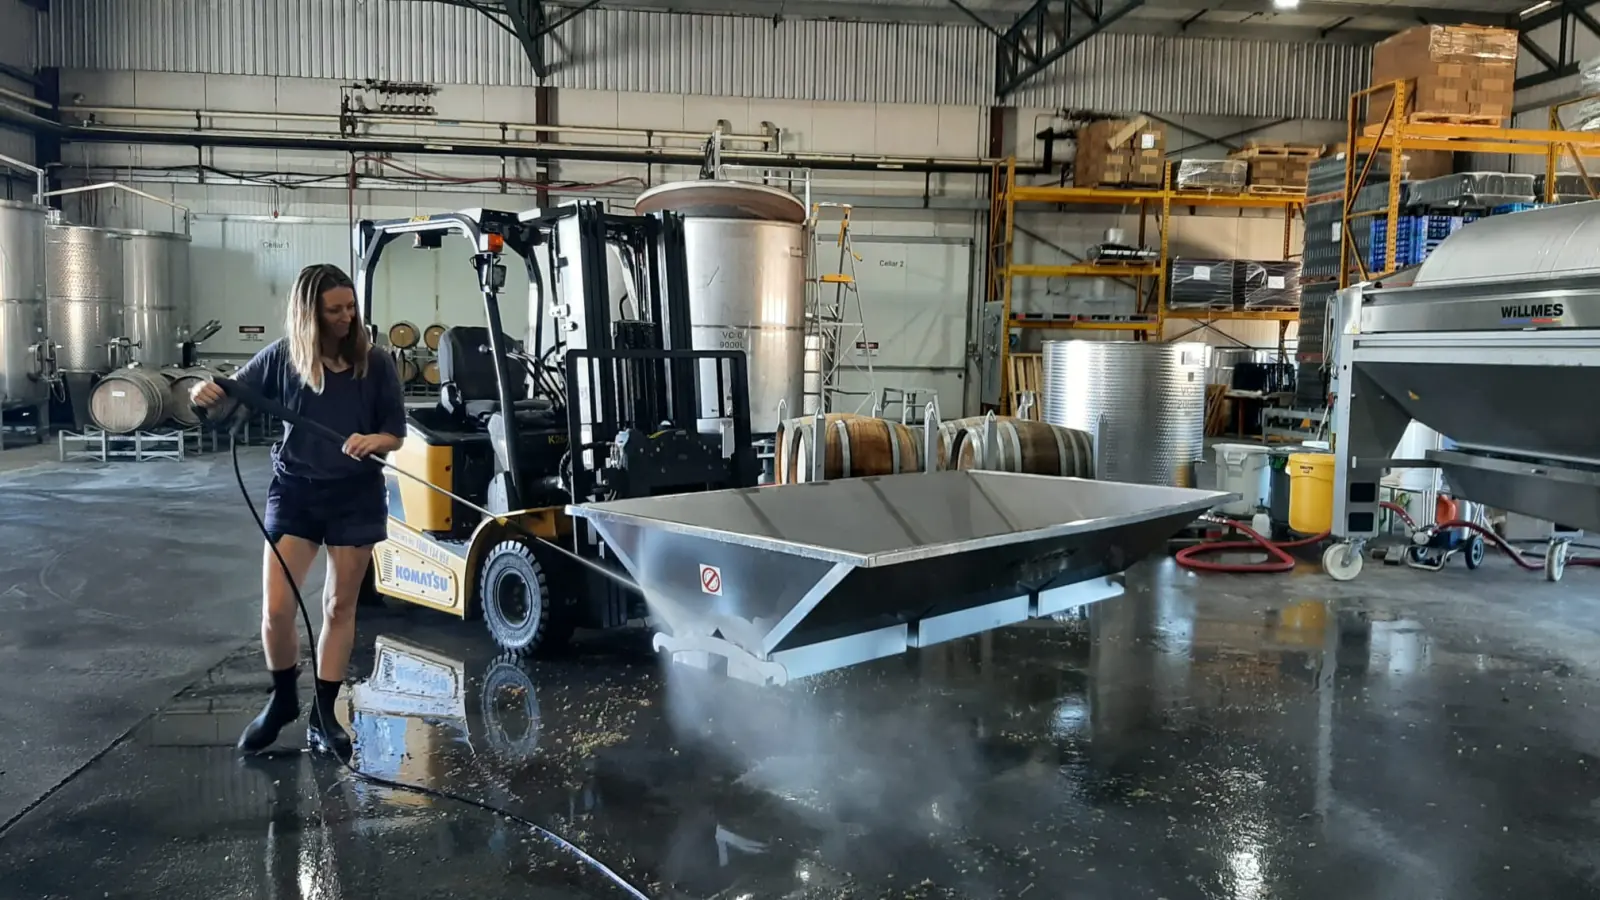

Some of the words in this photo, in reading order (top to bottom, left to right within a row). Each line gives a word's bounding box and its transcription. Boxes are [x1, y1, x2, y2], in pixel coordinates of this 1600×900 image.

[879, 259, 899, 267] Cellar
[719, 341, 745, 349] 9000L
[395, 565, 448, 591] KOMATSU
